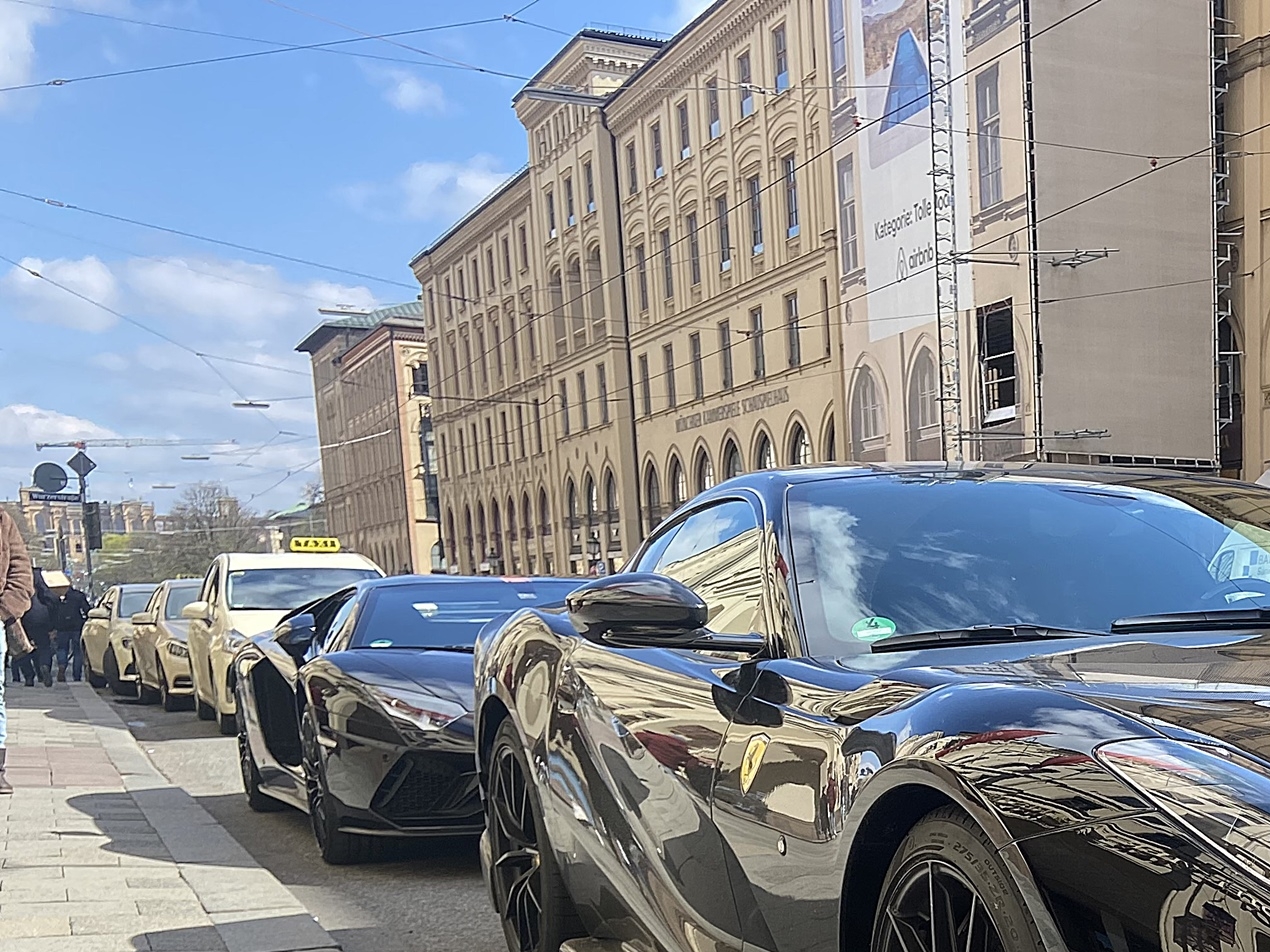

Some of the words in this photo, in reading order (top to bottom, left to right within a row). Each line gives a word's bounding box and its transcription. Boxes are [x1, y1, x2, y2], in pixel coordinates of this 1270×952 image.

[873, 210, 913, 240] Kategorie:
[913, 198, 932, 222] Tolle
[908, 242, 934, 269] airbnb
